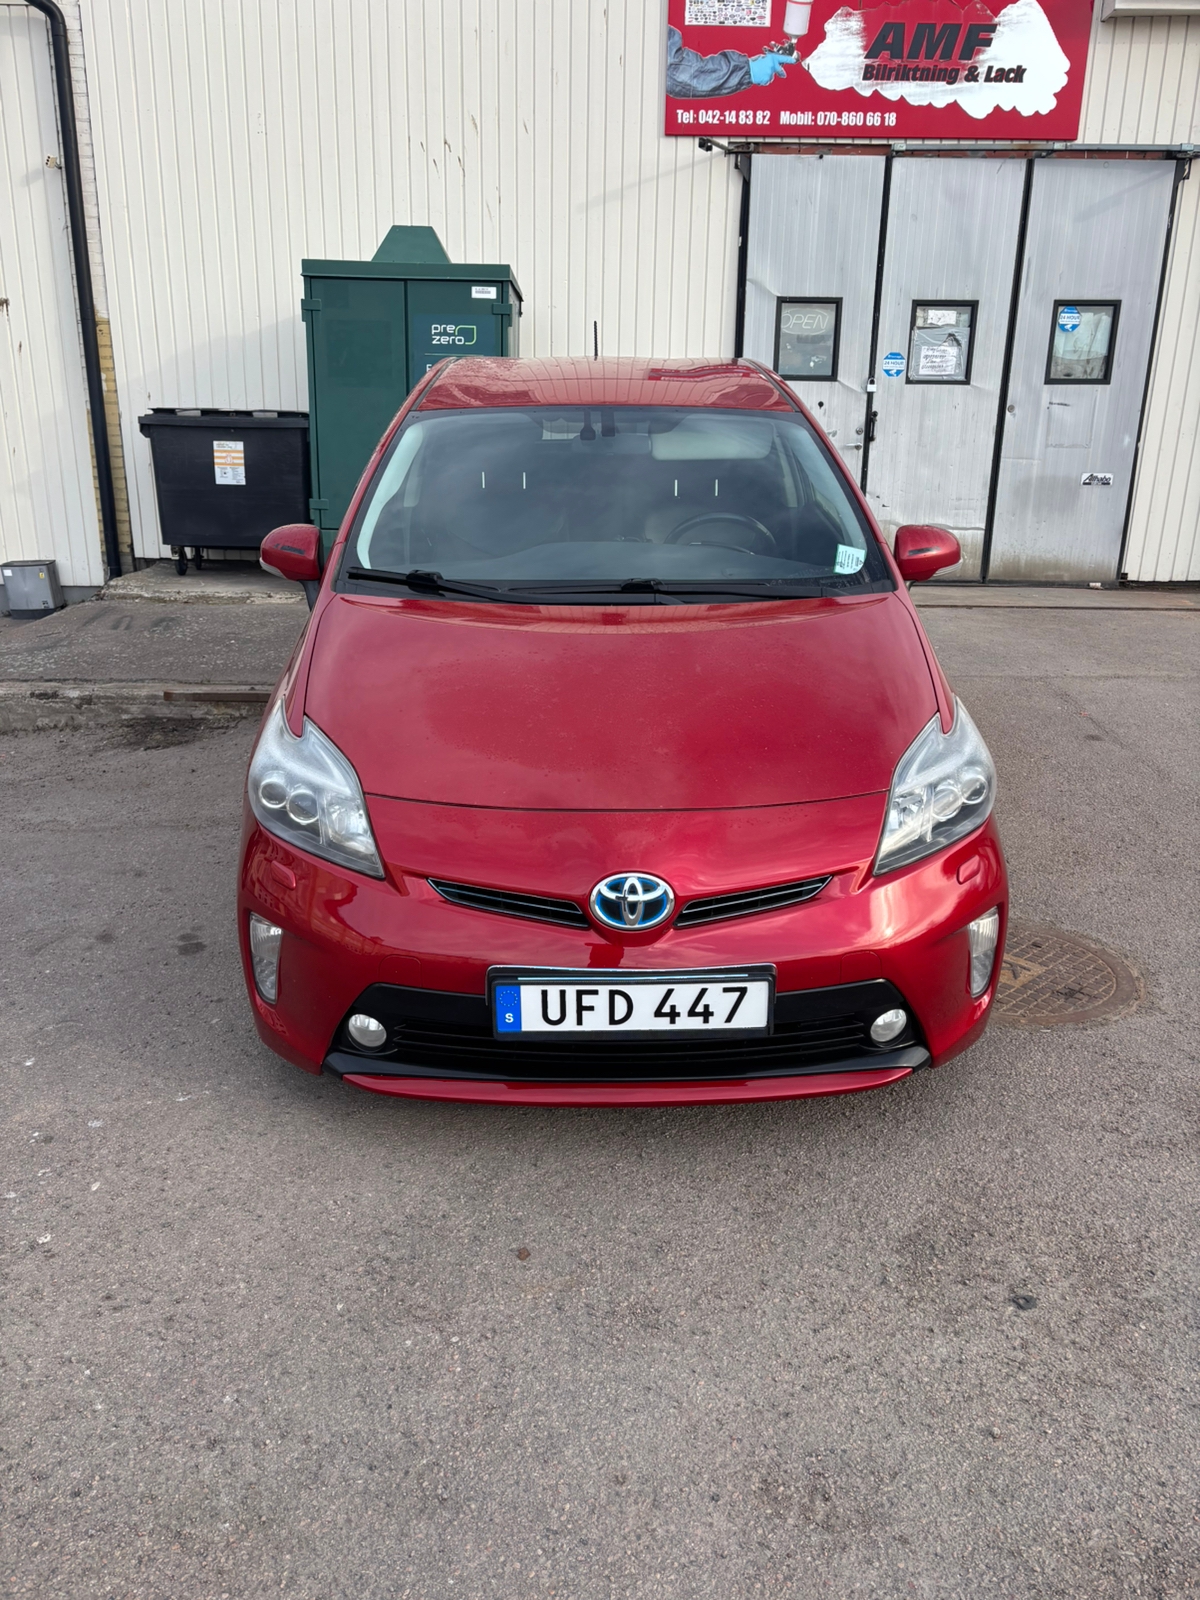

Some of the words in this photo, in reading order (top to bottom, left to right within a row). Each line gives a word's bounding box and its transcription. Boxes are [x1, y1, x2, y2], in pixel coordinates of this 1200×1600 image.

[864, 22, 998, 61] AMF
[862, 64, 960, 85] Bilriktning
[963, 65, 980, 83] &
[984, 65, 1027, 83] Lack
[676, 109, 697, 124] Tel:
[698, 109, 737, 125] 042-14
[738, 110, 754, 125] 83
[755, 110, 771, 125] 82
[779, 110, 815, 126] Mobil:
[816, 111, 865, 127] 070-860
[865, 112, 882, 127] 66
[883, 112, 898, 127] 18
[781, 313, 829, 329] OPEN
[431, 324, 455, 335] pre
[431, 335, 465, 345] zero
[540, 989, 635, 1027] UFD
[653, 986, 749, 1025] 447
[504, 1012, 515, 1024] S
